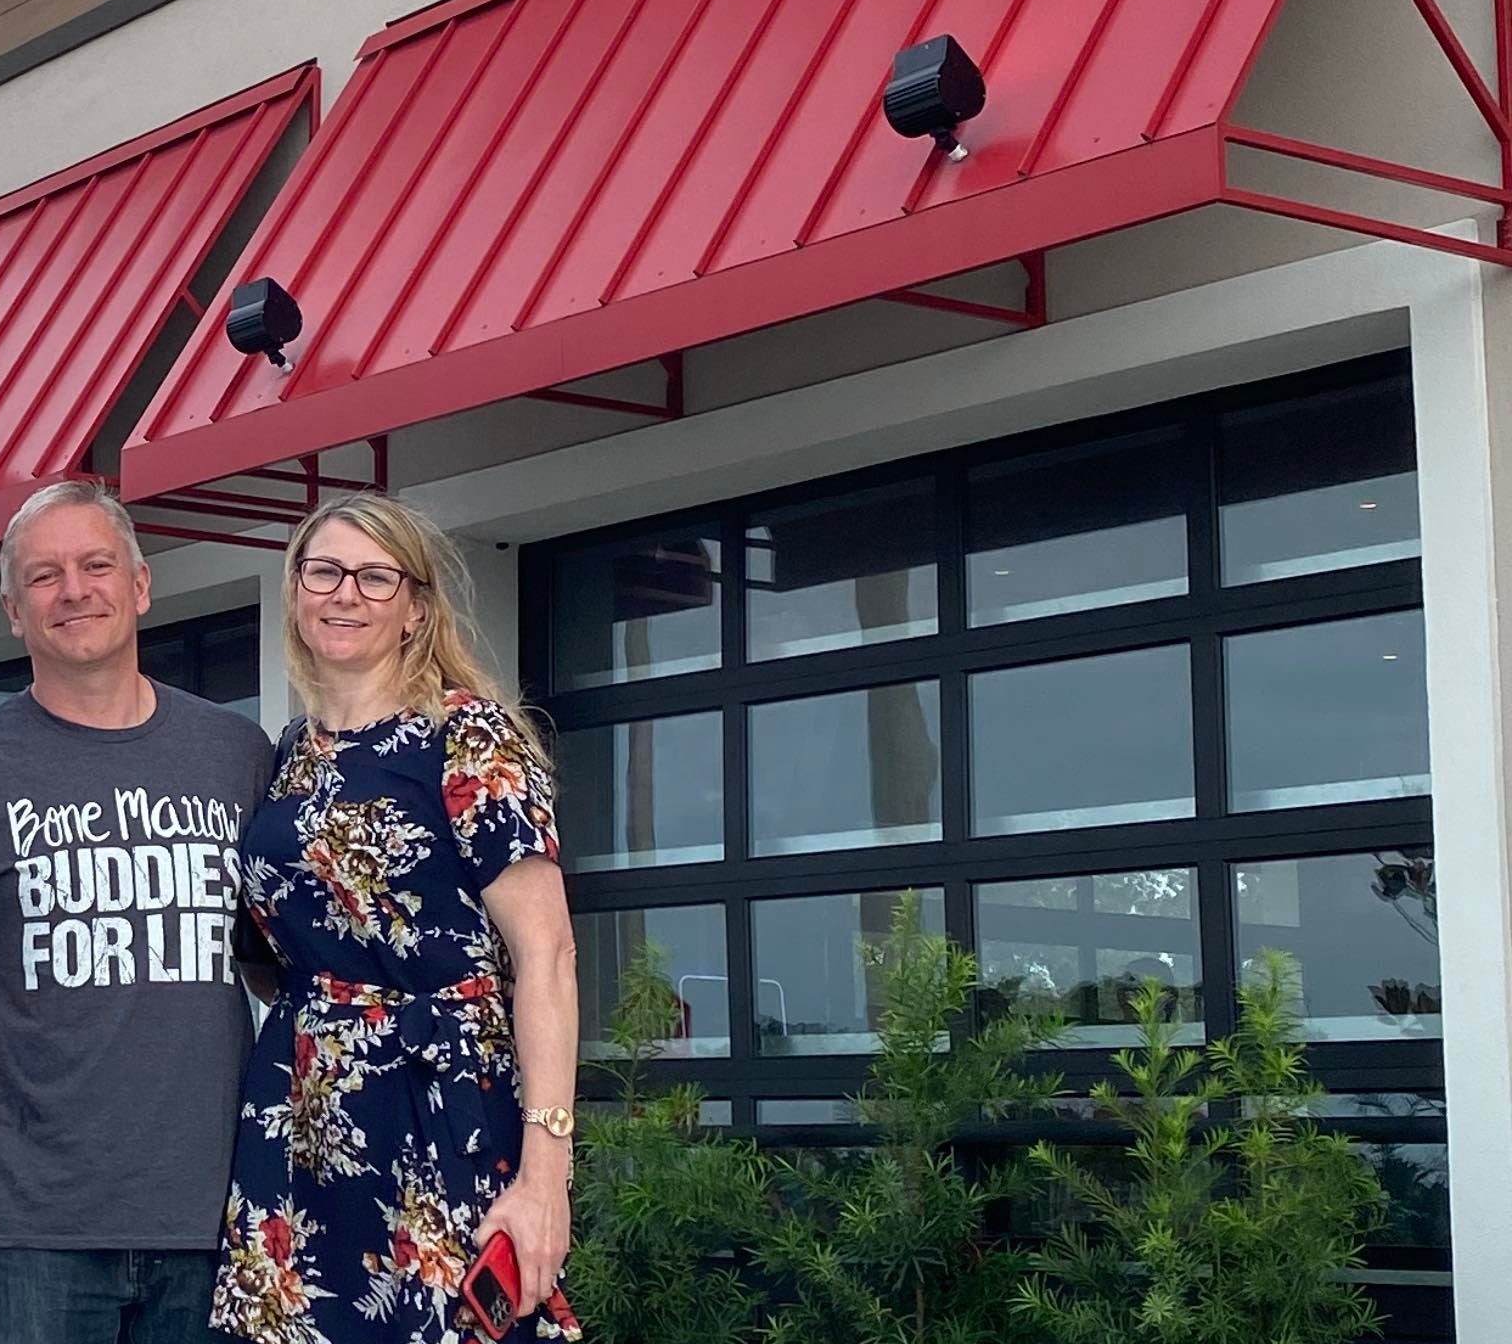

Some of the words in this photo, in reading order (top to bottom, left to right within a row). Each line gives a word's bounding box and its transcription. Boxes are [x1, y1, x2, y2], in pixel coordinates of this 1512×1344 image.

[6, 798, 111, 858] Bone
[114, 786, 244, 843] Marrow
[14, 842, 243, 918] BUDDIES
[22, 917, 136, 991] FOR
